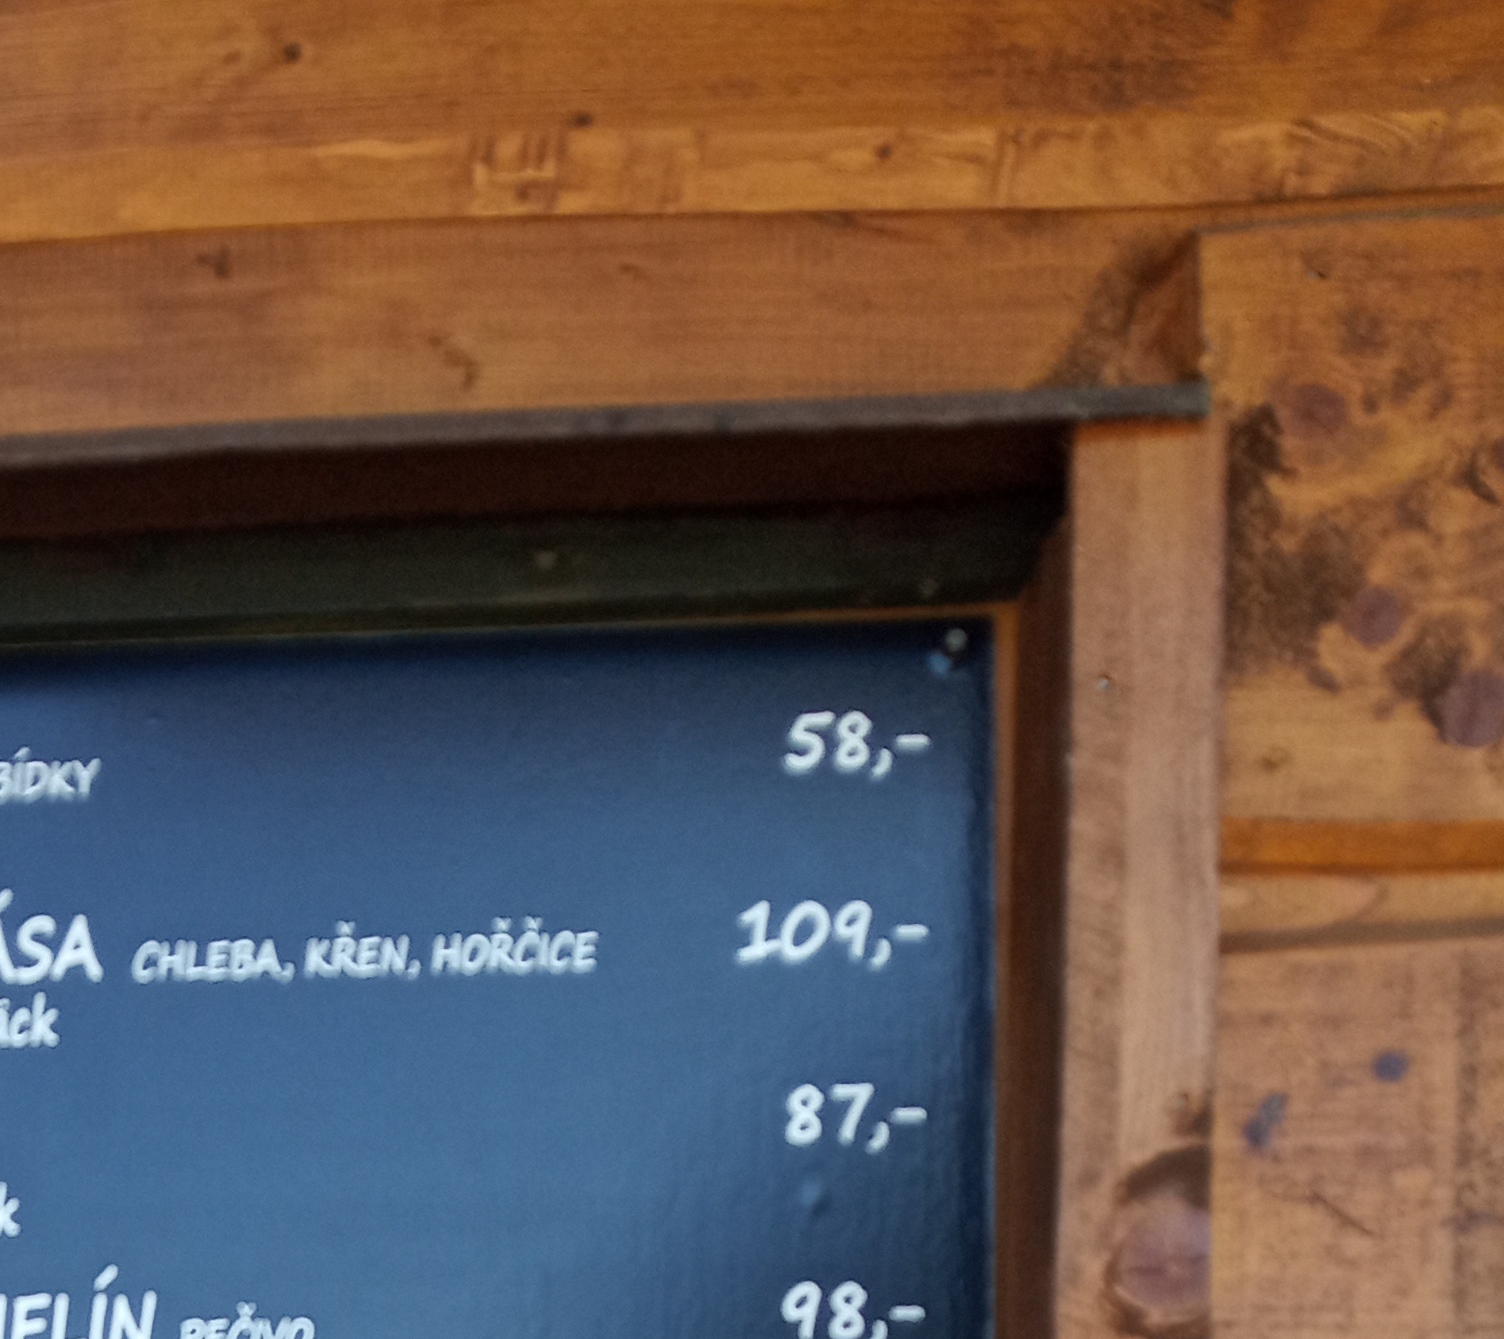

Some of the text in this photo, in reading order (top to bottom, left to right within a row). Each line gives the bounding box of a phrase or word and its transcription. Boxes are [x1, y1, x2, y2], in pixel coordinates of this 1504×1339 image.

[783, 710, 931, 780] 58,-
[130, 938, 295, 984] CHLEBA,
[303, 921, 422, 980] KŘEN,
[429, 916, 599, 976] HOŘČICE
[736, 899, 930, 970] 109,-
[785, 1082, 928, 1153] 87,-
